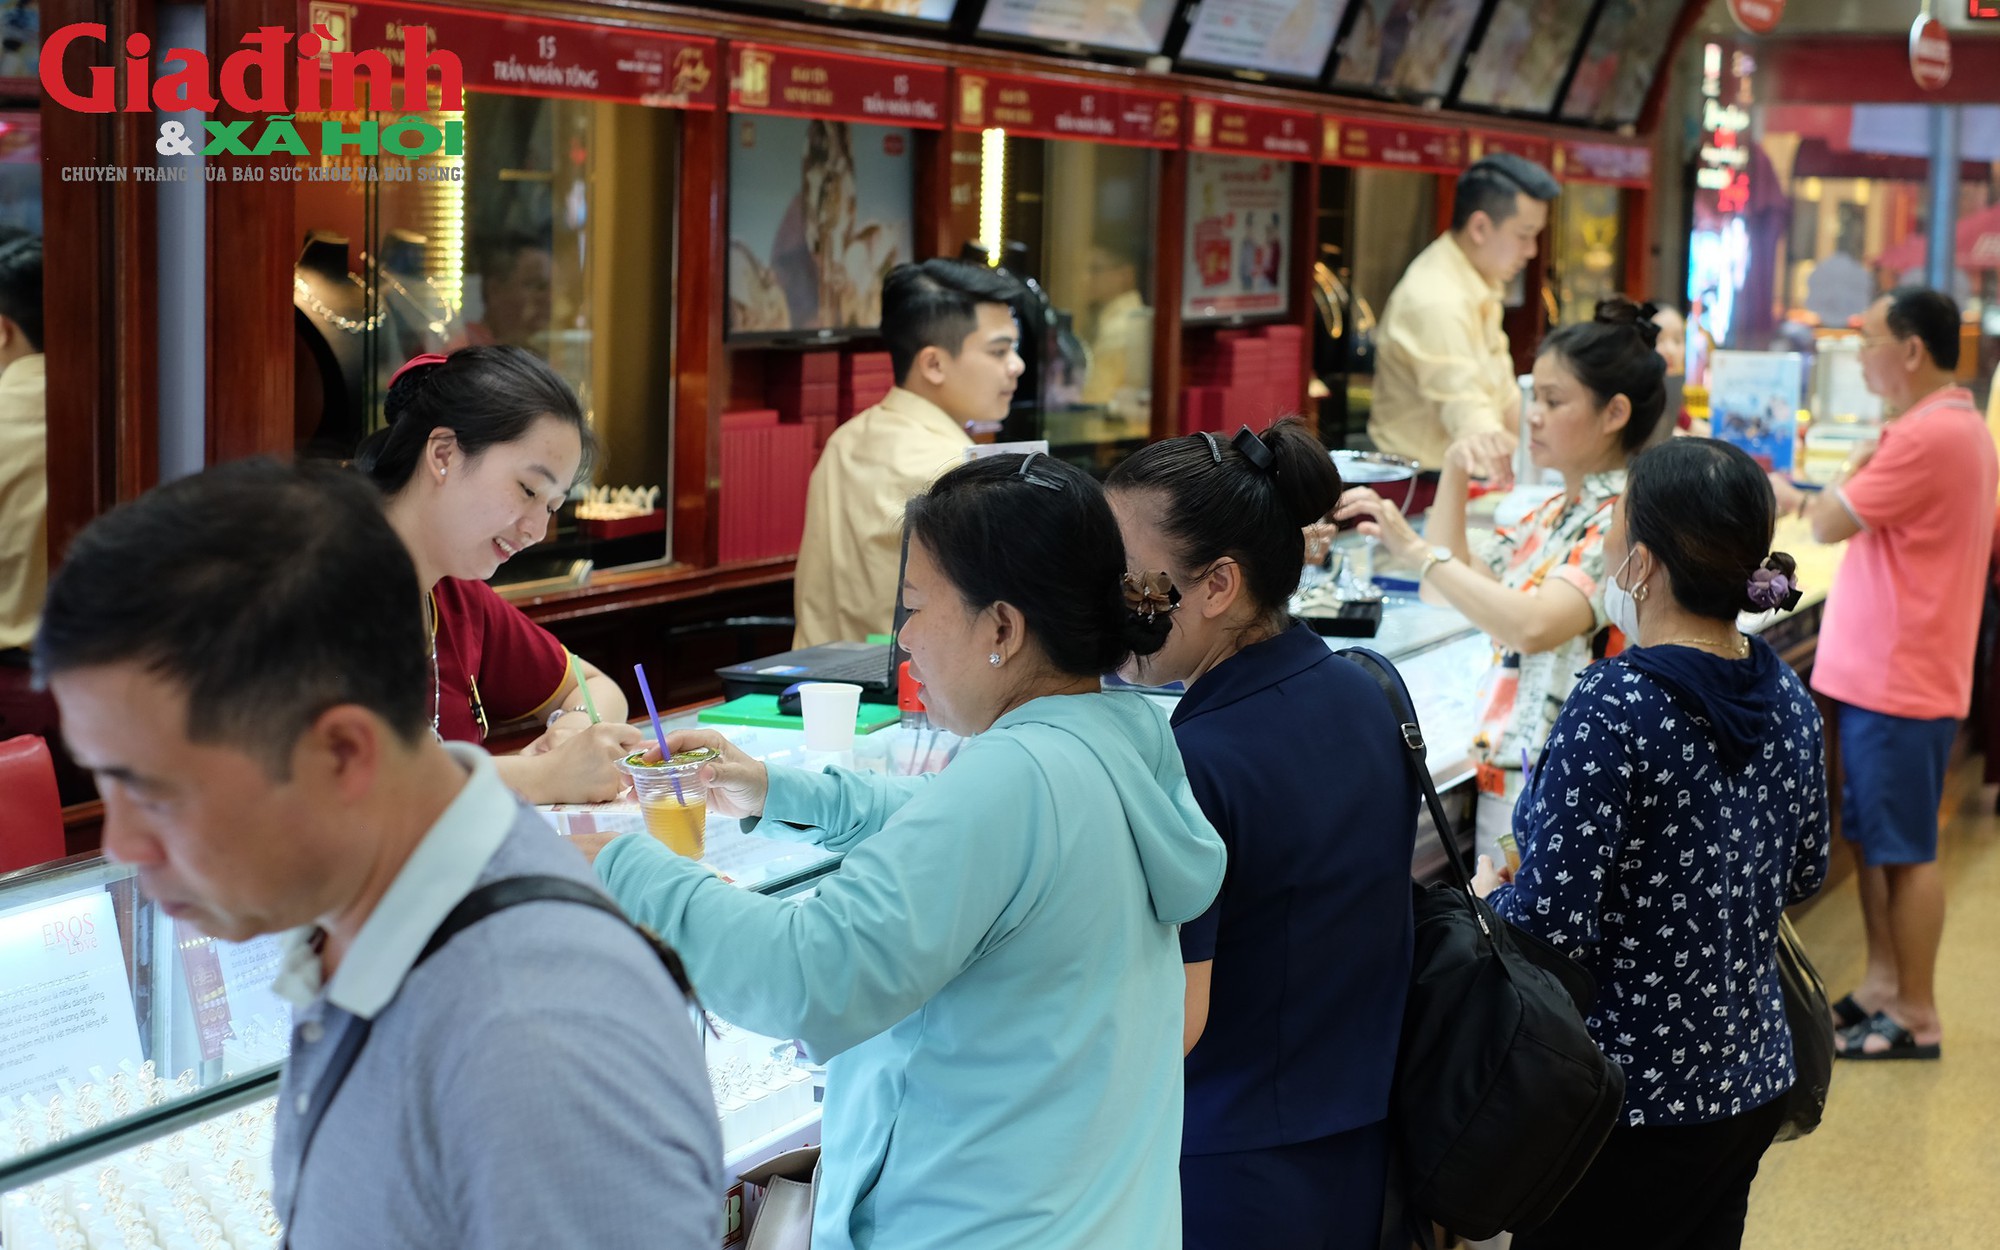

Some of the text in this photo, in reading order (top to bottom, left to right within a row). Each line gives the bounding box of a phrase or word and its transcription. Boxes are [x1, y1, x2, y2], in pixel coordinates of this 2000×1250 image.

[538, 35, 557, 59] 15
[1575, 722, 1590, 742] CK
[1682, 742, 1695, 761] CK
[1763, 741, 1775, 760] CK
[1565, 787, 1579, 807] CK
[1677, 790, 1690, 808] CK
[1547, 834, 1563, 853] CK
[1679, 848, 1694, 867] CK
[1536, 896, 1551, 915] CK
[1672, 893, 1687, 912] CK
[1603, 912, 1625, 925] CK
[42, 913, 95, 946] EROS
[1613, 958, 1636, 969] CK
[1667, 993, 1681, 1011] CK
[1629, 1109, 1645, 1127] CK
